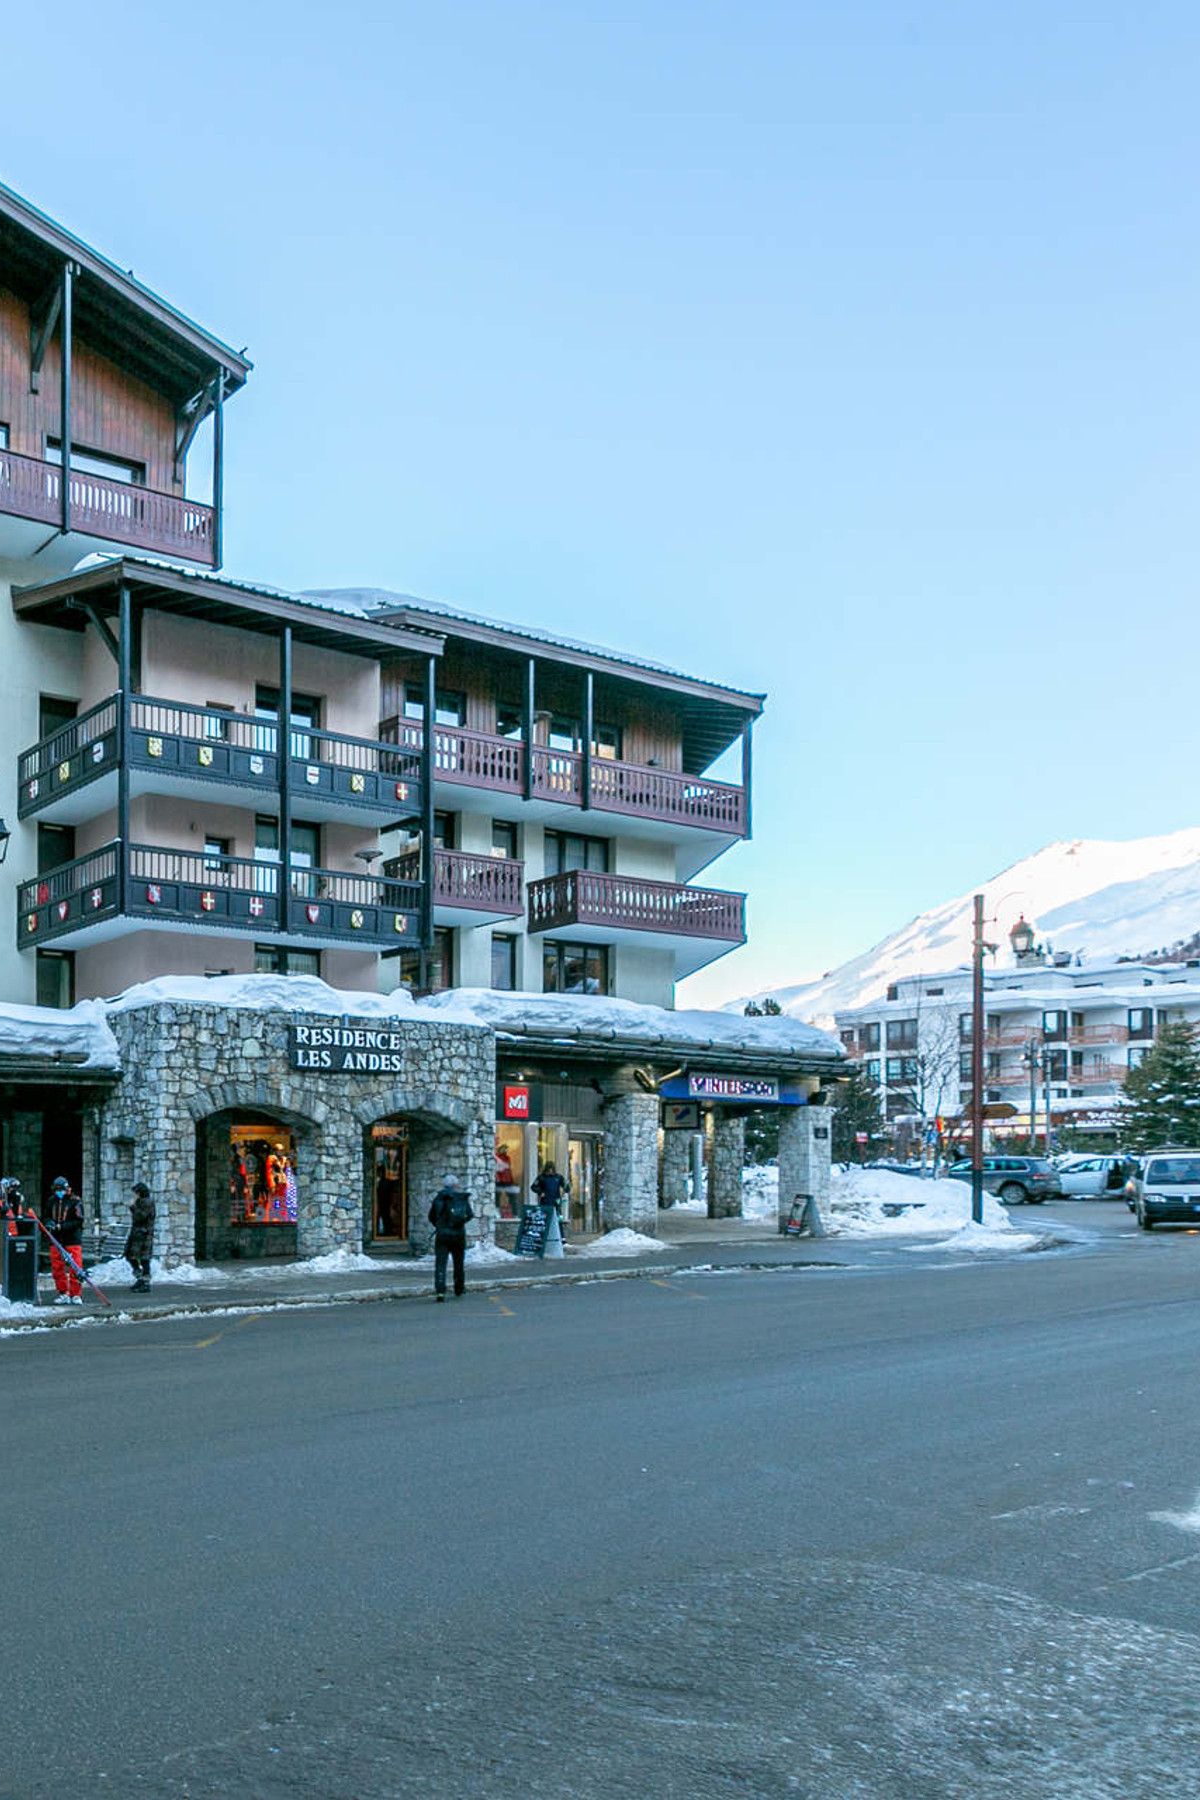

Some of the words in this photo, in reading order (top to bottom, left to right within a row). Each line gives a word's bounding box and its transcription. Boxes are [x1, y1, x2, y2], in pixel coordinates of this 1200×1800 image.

[296, 1026, 401, 1050] RESIDENCE
[297, 1049, 332, 1068] LES
[342, 1052, 401, 1072] ANDES
[704, 1077, 776, 1096] INTERSPORT
